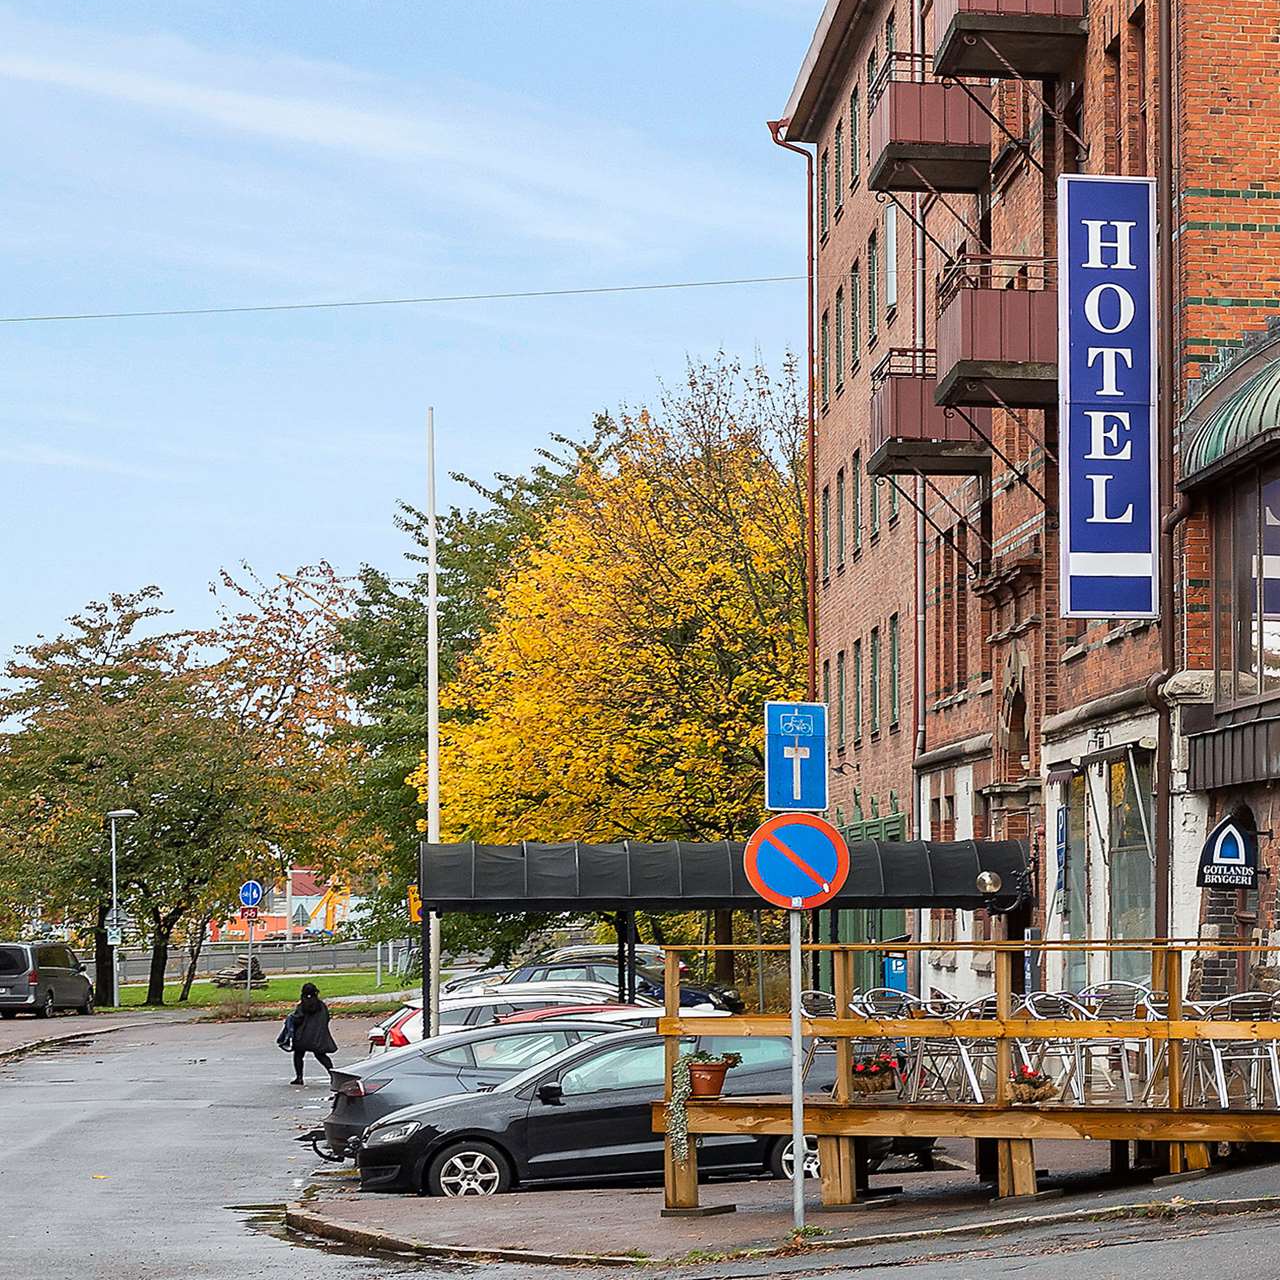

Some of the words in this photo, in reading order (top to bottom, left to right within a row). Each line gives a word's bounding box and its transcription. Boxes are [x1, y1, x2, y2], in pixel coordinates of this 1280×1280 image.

[1081, 219, 1137, 524] HOTEL
[1203, 865, 1254, 876] GOTLANDS
[1204, 874, 1252, 885] BRYGGERI
